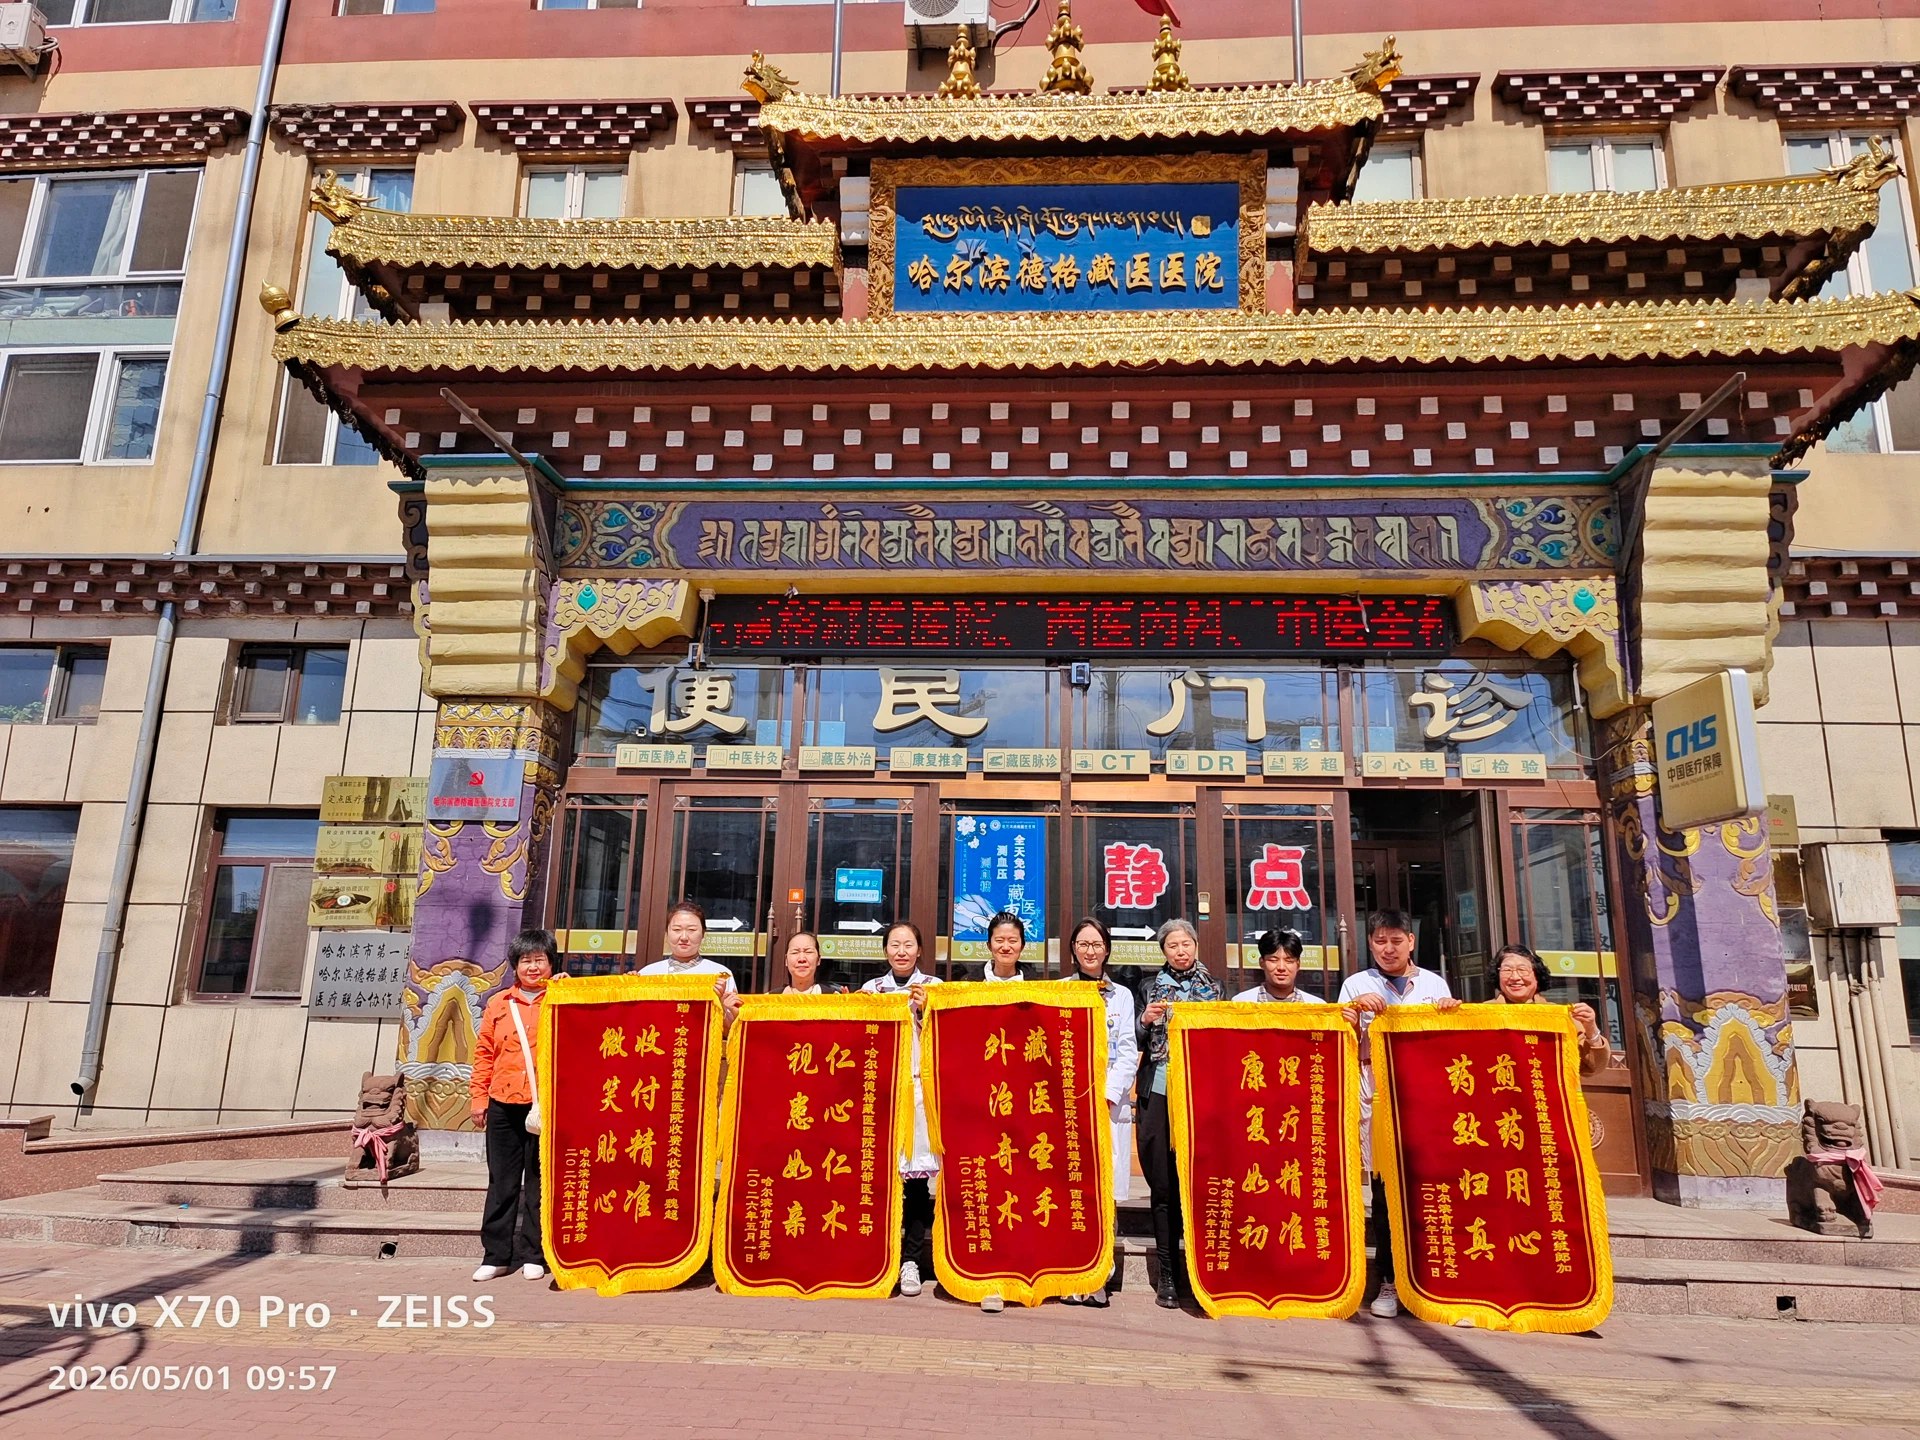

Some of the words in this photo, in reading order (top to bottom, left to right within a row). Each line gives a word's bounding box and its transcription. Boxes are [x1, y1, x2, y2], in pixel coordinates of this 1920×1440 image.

[907, 251, 1223, 290] 哈尔滨德格藏医医院
[637, 666, 1534, 741] 便民门诊
[638, 748, 690, 764] 西医静点
[1666, 714, 1716, 761] CHS
[728, 750, 778, 766] 中医针灸
[821, 751, 872, 767] 藏医外治
[912, 752, 963, 768] 康复推拿
[1006, 752, 1060, 768] 藏医脉诊
[1101, 754, 1136, 771] CT
[1197, 755, 1235, 771] DR
[1292, 756, 1338, 773] 彩超
[1392, 757, 1438, 773] 心电
[1492, 758, 1540, 775] 检验
[1667, 752, 1722, 782] 中国医疗保障
[996, 844, 1009, 880] 测血压
[1013, 834, 1026, 881] 全天免费
[623, 1024, 665, 1223] 收付精准
[821, 1042, 855, 1239] 仁心仁术
[984, 1027, 1023, 1231] 外治奇术
[1023, 1026, 1058, 1227] 藏医圣手
[1237, 1050, 1270, 1250] 康复如初
[1275, 1056, 1306, 1255] 理疗精准
[1445, 1054, 1496, 1261] 药效归真
[1487, 1053, 1542, 1255] 煎药用心
